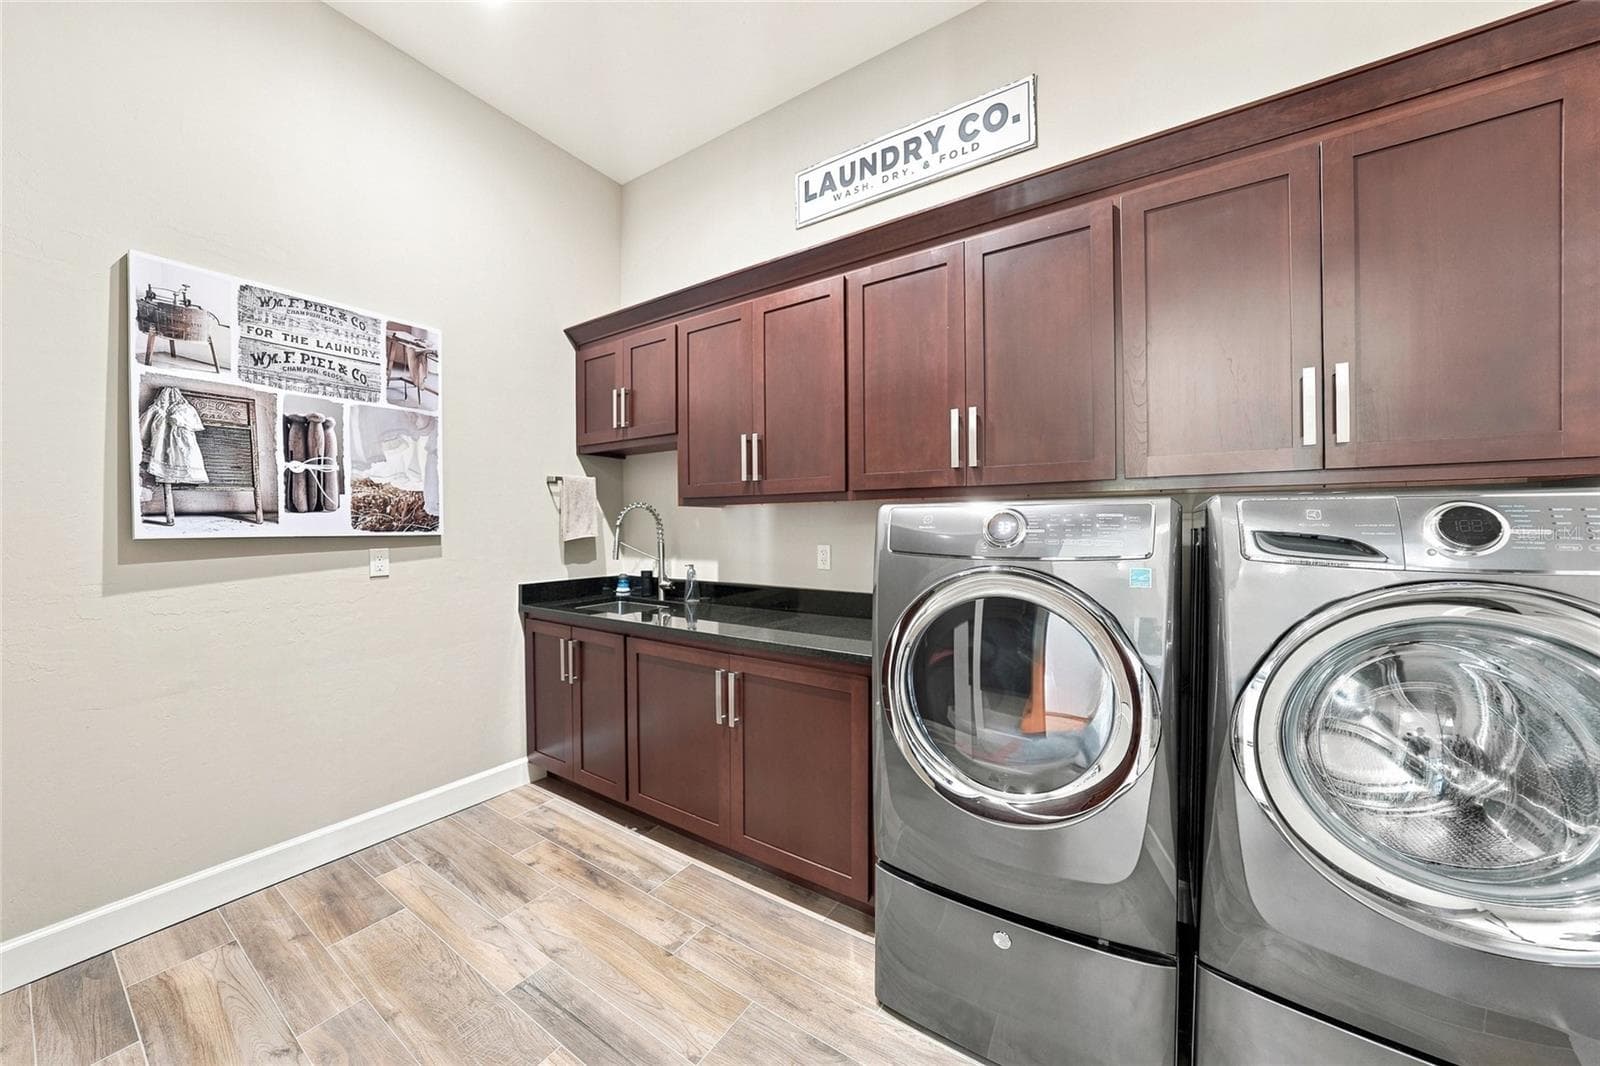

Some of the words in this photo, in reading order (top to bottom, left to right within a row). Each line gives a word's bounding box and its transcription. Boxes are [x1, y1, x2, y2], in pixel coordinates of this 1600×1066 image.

[804, 124, 946, 203] LAUNDRY
[958, 102, 1021, 143] CO.
[922, 160, 931, 169] &
[939, 142, 980, 164] FOLD
[303, 299, 336, 317] PIEL
[339, 311, 347, 322] &
[246, 325, 274, 338] FOR
[281, 332, 309, 346] THE
[316, 339, 380, 360] LAUNDRY.
[282, 366, 319, 375] CHAMPION
[300, 352, 336, 371] PIEL
[338, 363, 348, 376] &
